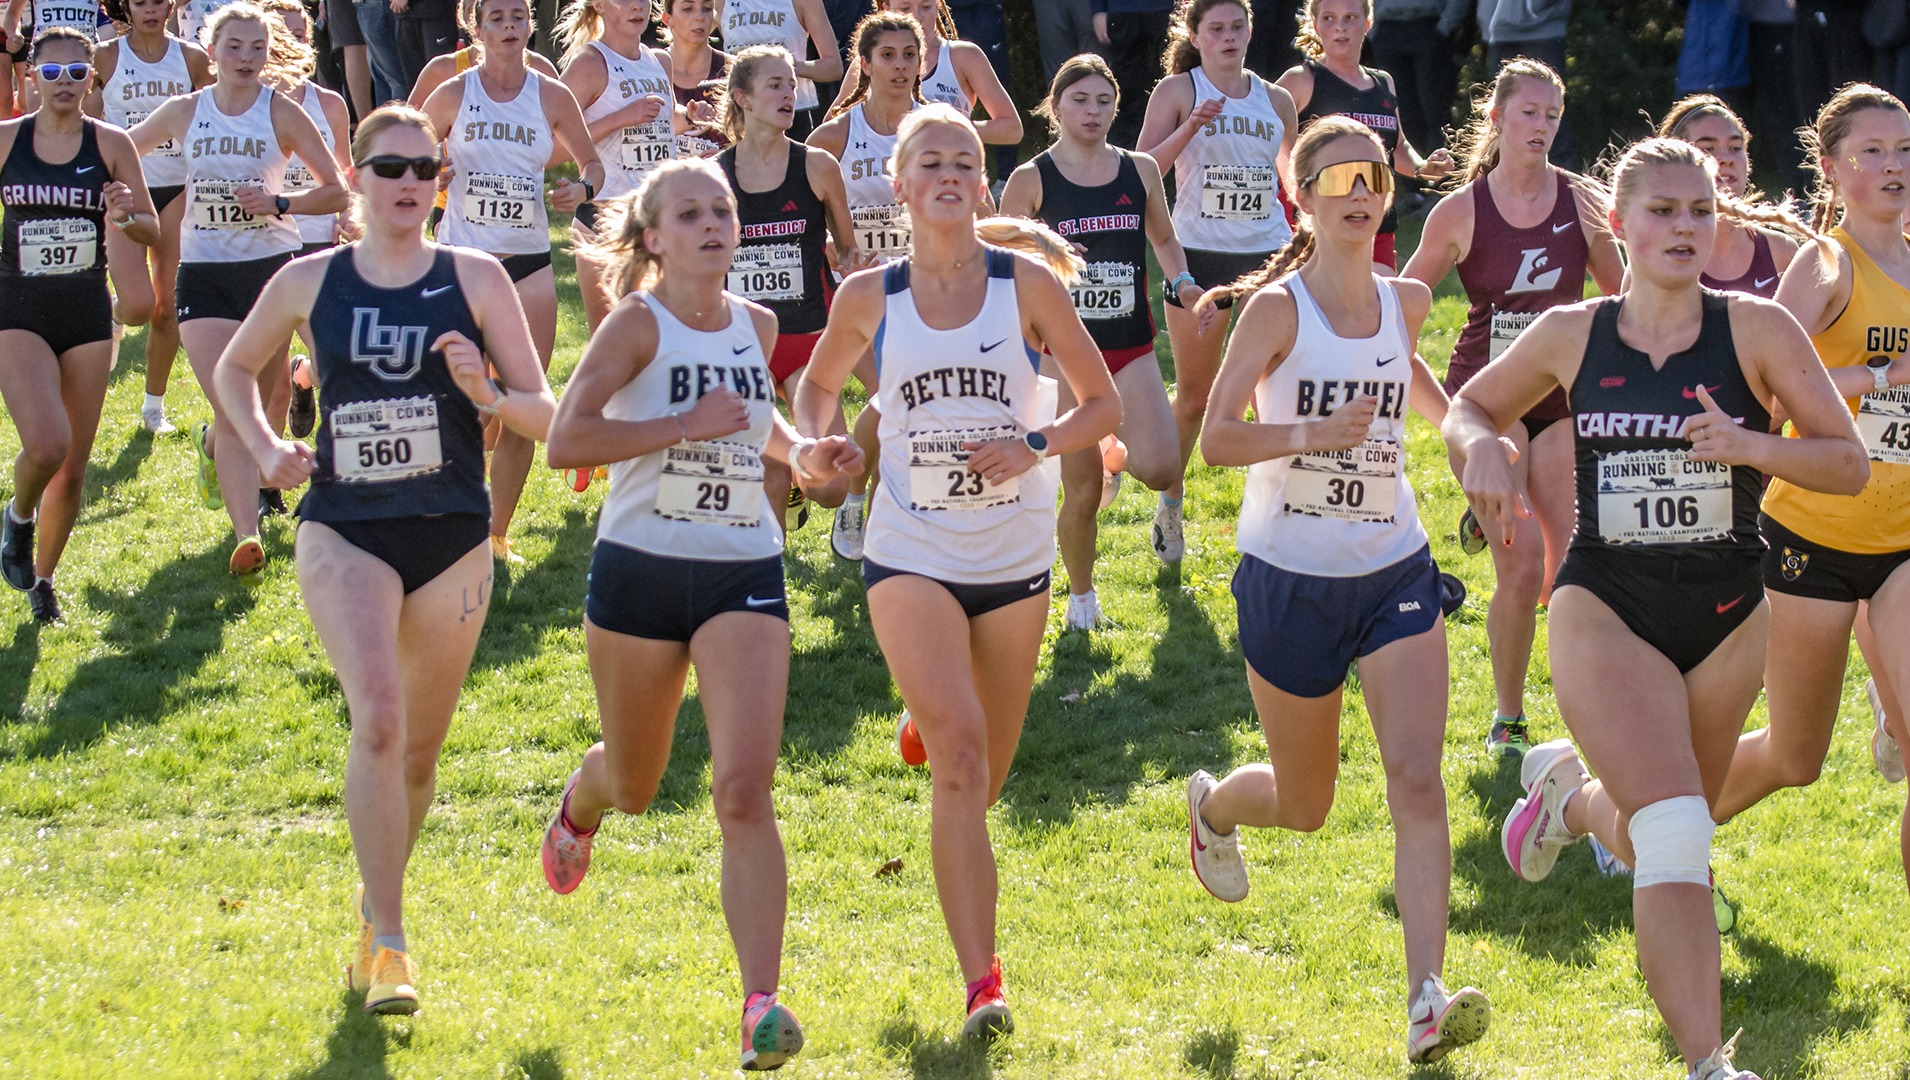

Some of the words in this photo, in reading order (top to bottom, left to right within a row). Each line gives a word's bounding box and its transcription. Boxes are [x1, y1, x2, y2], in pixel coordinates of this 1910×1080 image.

[42, 7, 95, 23] STOUT
[728, 12, 747, 30] ST.
[749, 11, 785, 27] OLAF
[123, 82, 145, 100] ST.
[619, 79, 643, 98] ST.
[464, 121, 489, 142] ST.
[492, 121, 536, 147] OLAF
[624, 126, 654, 136] RUNNING
[1205, 115, 1231, 137] ST.
[1233, 116, 1275, 142] OLAF
[192, 137, 216, 159] ST.
[219, 136, 266, 159] OLAF
[634, 145, 670, 162] 1126
[851, 157, 878, 180] ST.
[1206, 171, 1244, 181] RUNNING
[1251, 173, 1273, 182] COWS
[195, 186, 230, 195] RUNNING
[469, 178, 504, 190] RUNNING
[512, 182, 535, 193] COWS
[3, 184, 105, 211] GRINNELL
[1216, 192, 1263, 212] 1124
[477, 198, 524, 220] 1132
[853, 211, 890, 221] RUNNING
[22, 225, 60, 237] RUNNING
[69, 223, 95, 234] COWS
[745, 219, 807, 238] BENEDICT
[1058, 219, 1080, 236] ST.
[1079, 214, 1140, 233] BENEDICT
[40, 245, 78, 266] 397
[733, 252, 765, 263] UNNING
[774, 250, 800, 260] COWS
[741, 271, 791, 293] 1036
[1108, 267, 1133, 278] COWS
[1071, 289, 1122, 309] 1026
[1494, 319, 1532, 330] RUNNIN
[351, 306, 429, 380] LU
[1866, 325, 1909, 353] GUS
[900, 367, 1011, 412] BETHEL
[1864, 388, 1910, 403] RUNNIN
[335, 410, 383, 426] RUNNING
[396, 405, 434, 420] COWS
[1576, 411, 1744, 439] CARTHA
[358, 437, 412, 468] 560
[668, 447, 720, 464] RUNNING
[732, 453, 760, 469] COWS
[1365, 450, 1397, 464] COWS
[1624, 454, 1666, 463] CARLETON
[1602, 462, 1666, 479] RUNNING
[1683, 461, 1728, 474] COWS
[947, 469, 984, 497] 23
[1325, 477, 1365, 508] 30
[696, 482, 730, 512] 29
[1633, 495, 1699, 529] 106
[1669, 527, 1714, 535] CHAMPIONSHIP
